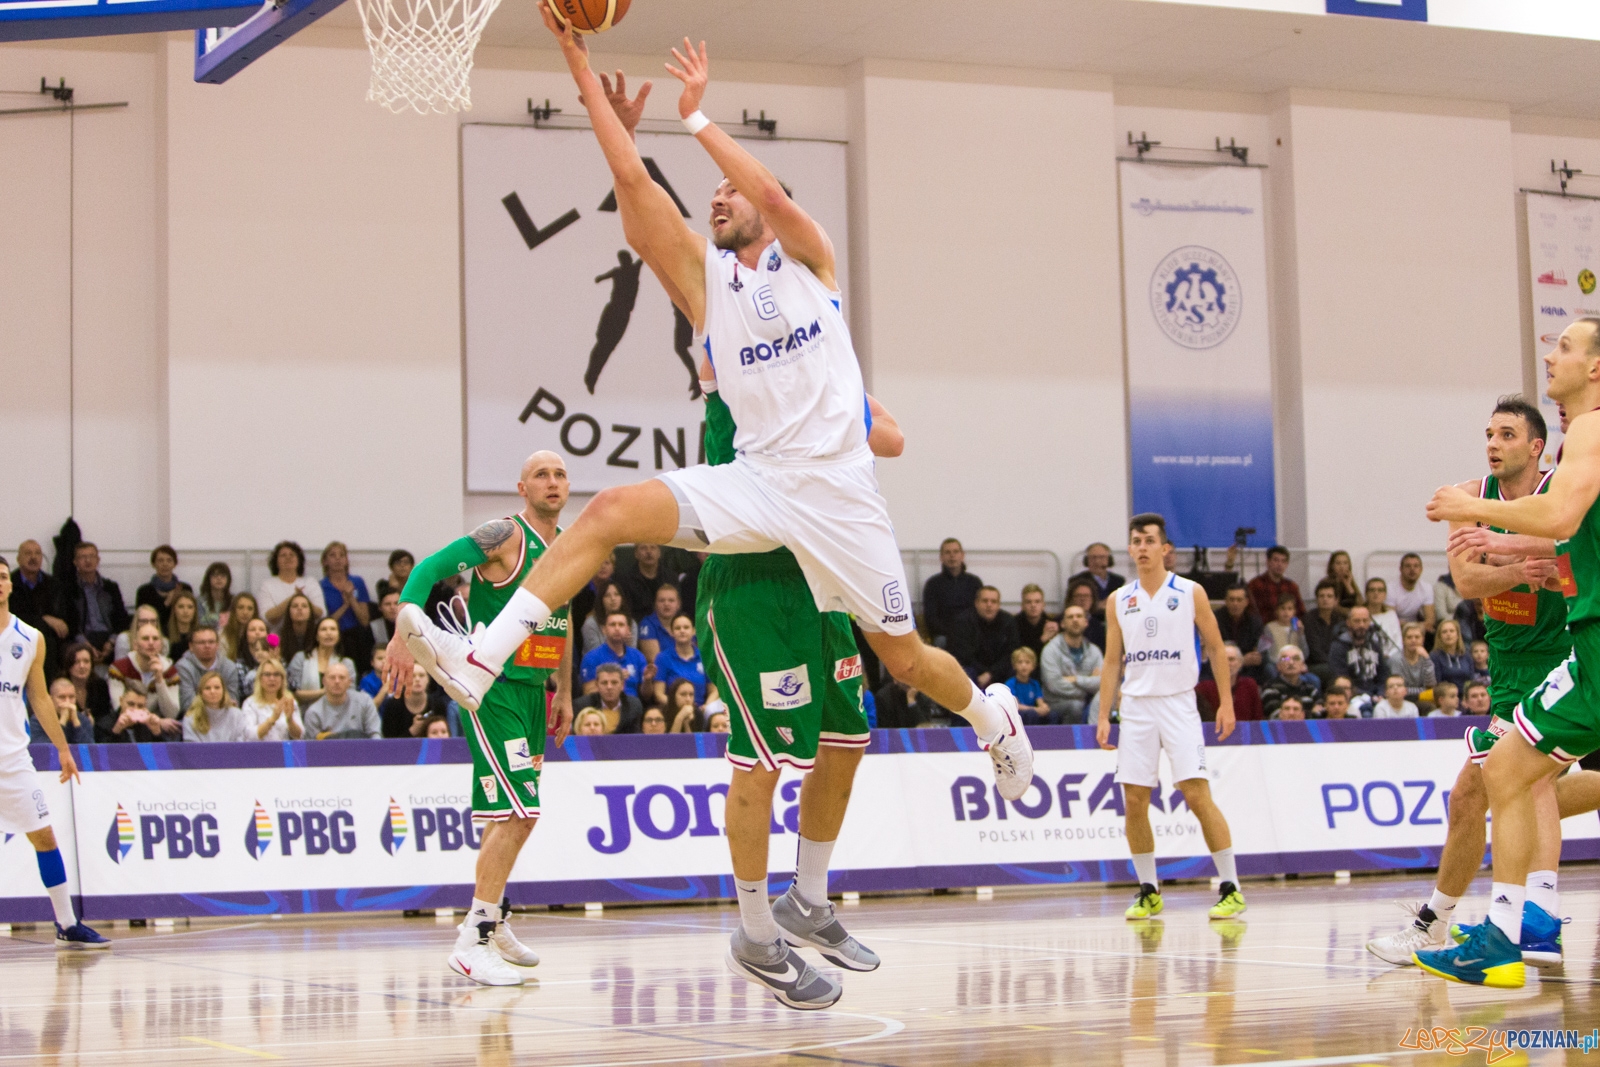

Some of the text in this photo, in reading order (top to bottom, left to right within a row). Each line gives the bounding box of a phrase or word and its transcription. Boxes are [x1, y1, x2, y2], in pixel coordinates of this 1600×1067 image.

[752, 284, 780, 320] 6
[740, 319, 821, 366] BOFARM
[518, 386, 707, 470] POZN
[882, 580, 904, 614] 6
[1144, 616, 1159, 638] 9
[1127, 649, 1181, 662] BIOFARM
[32, 788, 47, 811] 2
[137, 799, 217, 813] fundacja
[274, 796, 352, 810] fundacja
[1321, 780, 1451, 829] POZ
[140, 813, 221, 860] PBG
[277, 810, 357, 856] PBG
[411, 807, 485, 852] PBG
[978, 822, 1198, 843] POLSKI PRODUCEN EKÓW
